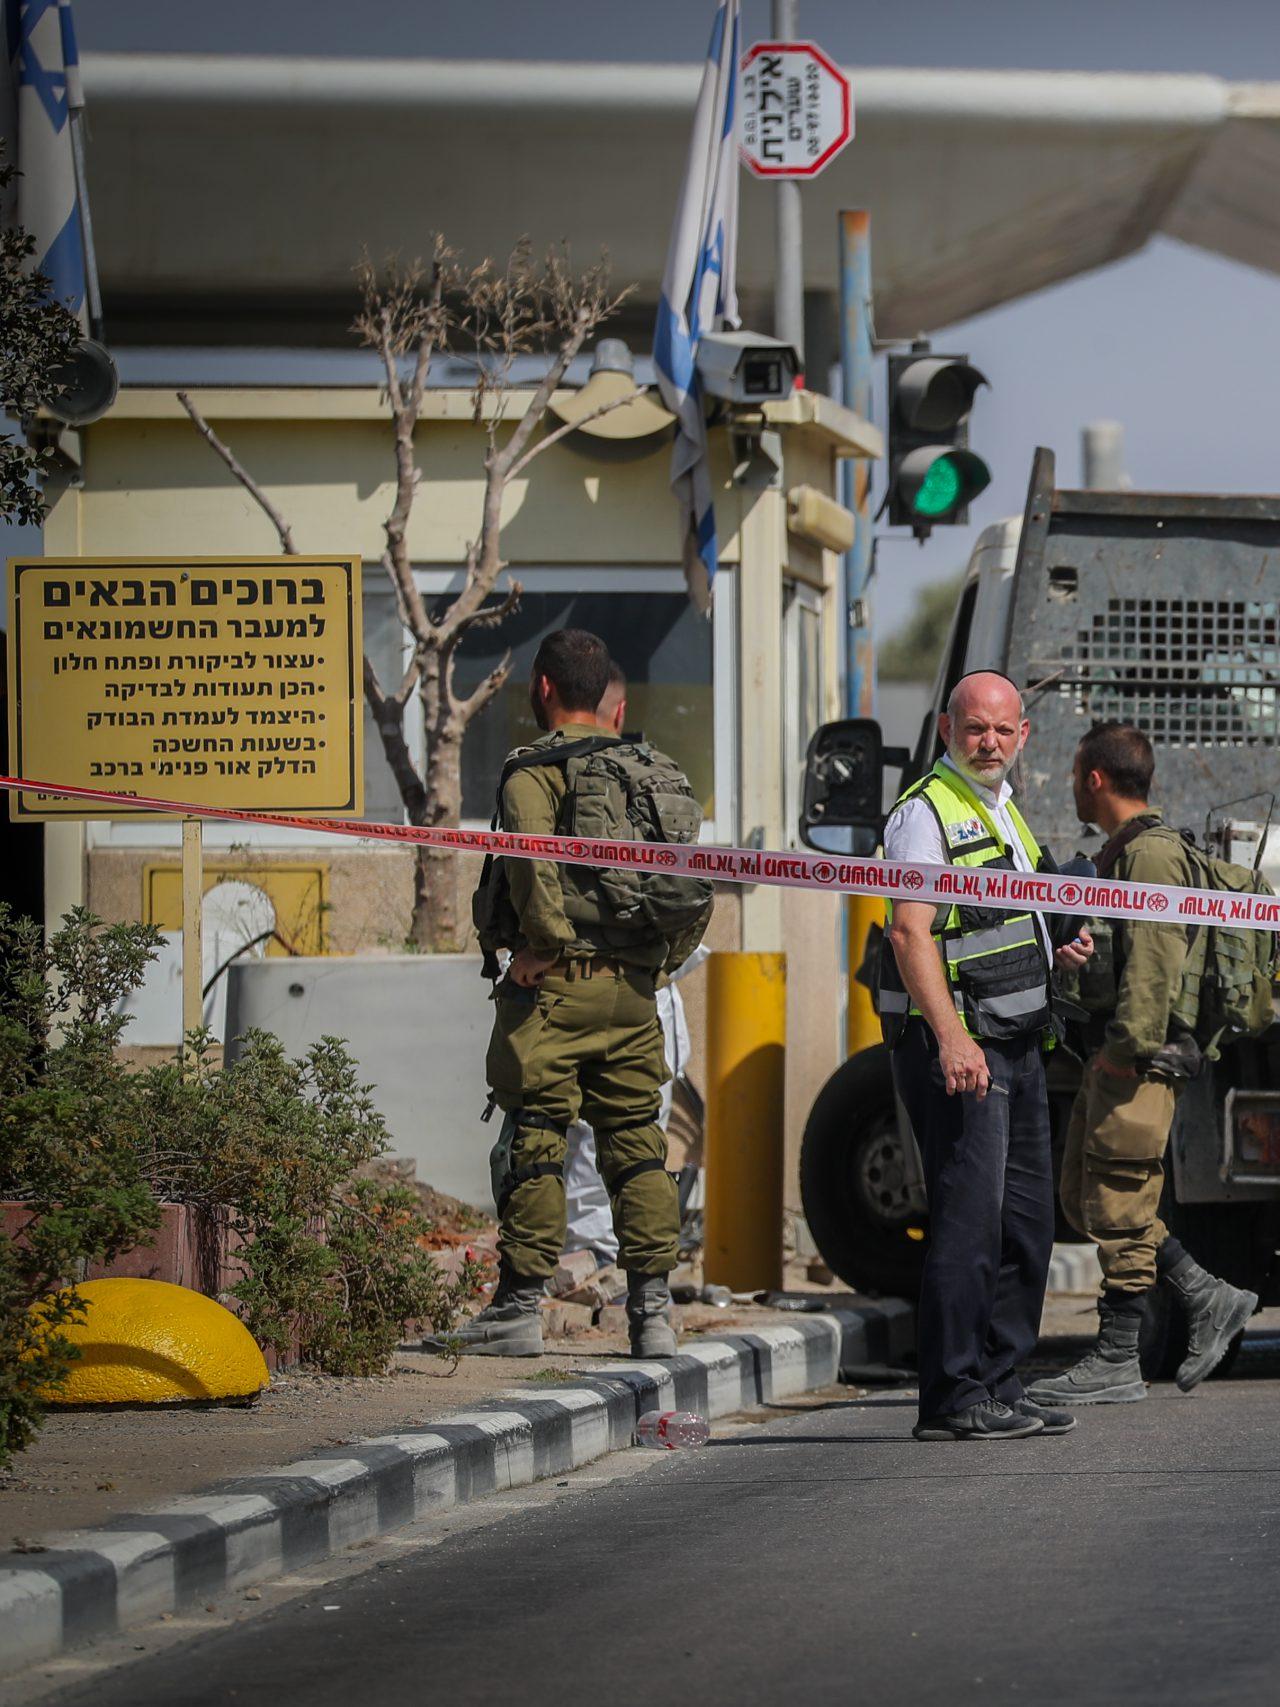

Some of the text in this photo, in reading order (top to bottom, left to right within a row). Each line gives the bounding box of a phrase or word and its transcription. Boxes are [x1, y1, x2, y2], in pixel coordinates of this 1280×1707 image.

[759, 56, 783, 162] אילנית
[787, 77, 802, 141] שערים
[44, 579, 325, 607] ברוכים הבאים
[44, 614, 325, 640] למעבר החשמונאים
[54, 651, 315, 674] עצור לביקורת ופתח חלון
[105, 679, 315, 701] הכן תעודות לבדיקה
[87, 707, 315, 730] היצמד לעמדת הבודק
[153, 737, 316, 753] בשעות החשכה
[90, 756, 316, 778] הדלק אור פנימי ברכב
[517, 838, 564, 855] מעבר
[592, 844, 656, 865] משטרת
[688, 853, 736, 877] ישראל
[739, 854, 761, 876] אין
[764, 857, 811, 880] מעבר
[838, 864, 902, 888] משטרת
[934, 873, 982, 901] ישראל
[985, 874, 1008, 898] אין
[1010, 880, 1056, 903] מעבר
[1083, 885, 1147, 910] משטרת
[1178, 896, 1227, 922] ישראל
[1229, 898, 1252, 920] אין
